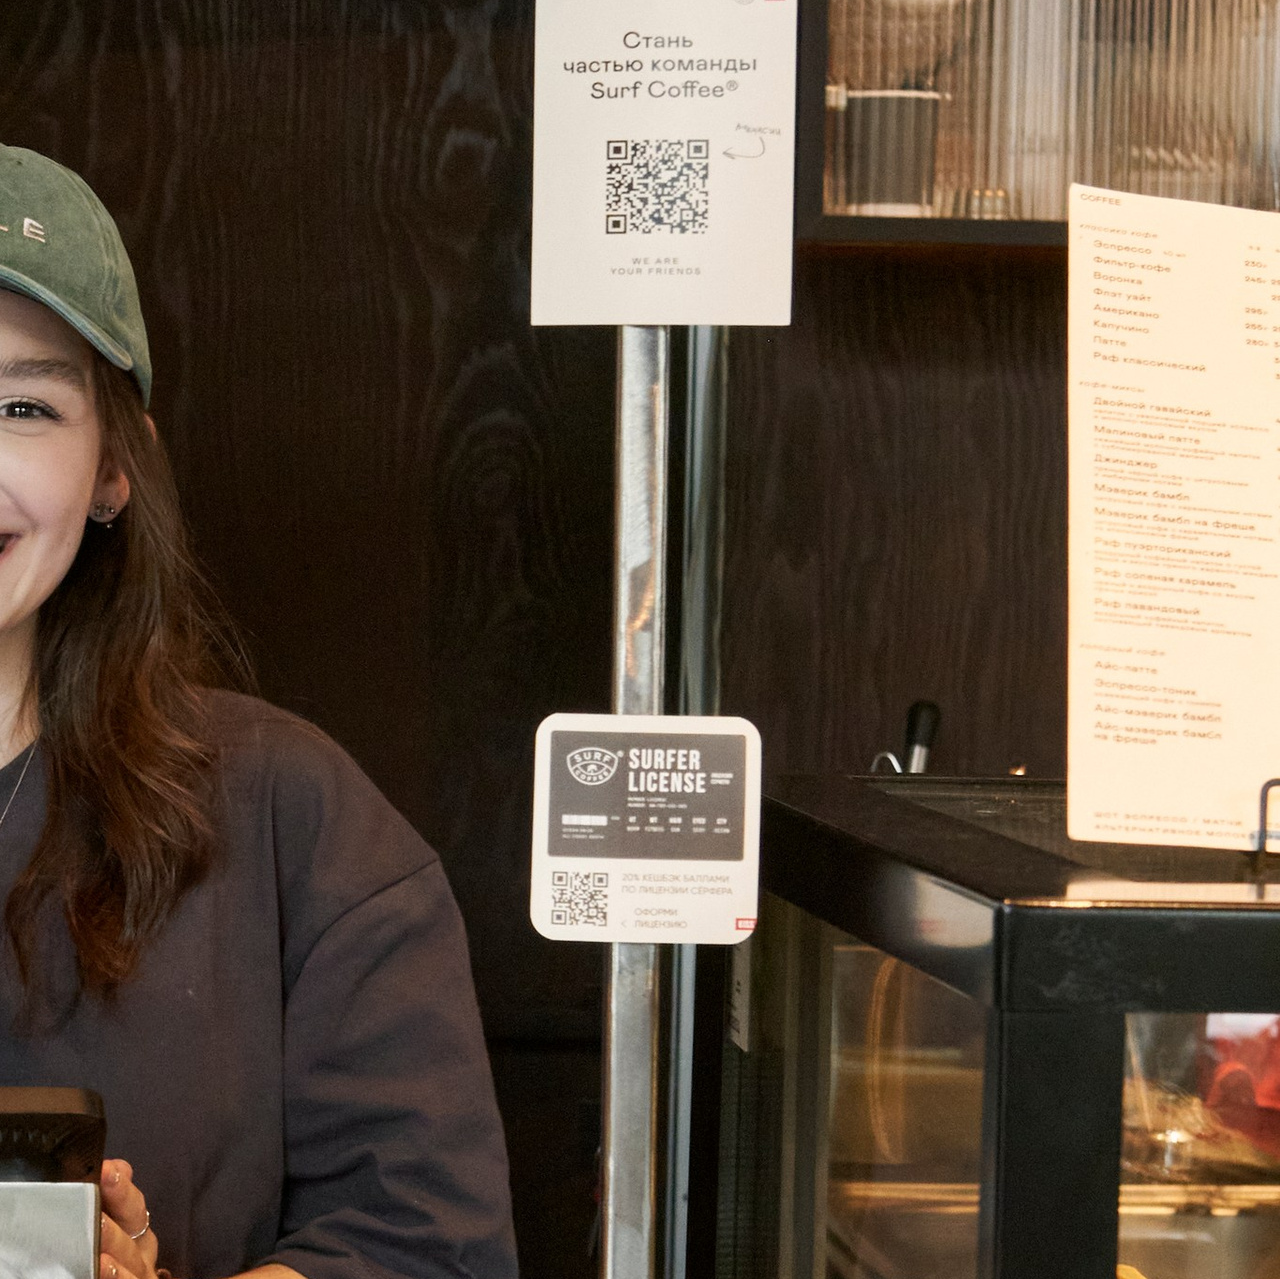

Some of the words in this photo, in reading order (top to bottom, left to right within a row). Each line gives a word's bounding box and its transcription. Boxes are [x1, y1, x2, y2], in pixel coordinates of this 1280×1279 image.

[623, 32, 693, 49] Стань
[563, 59, 643, 73] частью
[651, 58, 757, 74] команды
[591, 81, 642, 99] Surf
[1080, 193, 1121, 206] COFFEE
[1093, 239, 1152, 255] Эспрессо
[1093, 256, 1171, 273] Фильтр-кофе
[1093, 271, 1143, 285] Воронка
[1093, 303, 1160, 319] Американо
[1093, 319, 1150, 334] Капучино
[1093, 351, 1119, 363] Раф
[1123, 356, 1207, 372] классический
[1092, 396, 1146, 410] Двойной
[1149, 404, 1213, 418] гавайский
[1093, 425, 1165, 440] Малиновый
[1093, 454, 1158, 469] Джинджер
[1094, 536, 1121, 548] Раф
[1094, 597, 1121, 609] Раф
[1094, 678, 1197, 697] Эспрессо-тоник
[574, 751, 610, 764] SURF
[628, 748, 701, 770] SURFER
[574, 768, 611, 782] COFFEE
[628, 772, 707, 793] LICENSE
